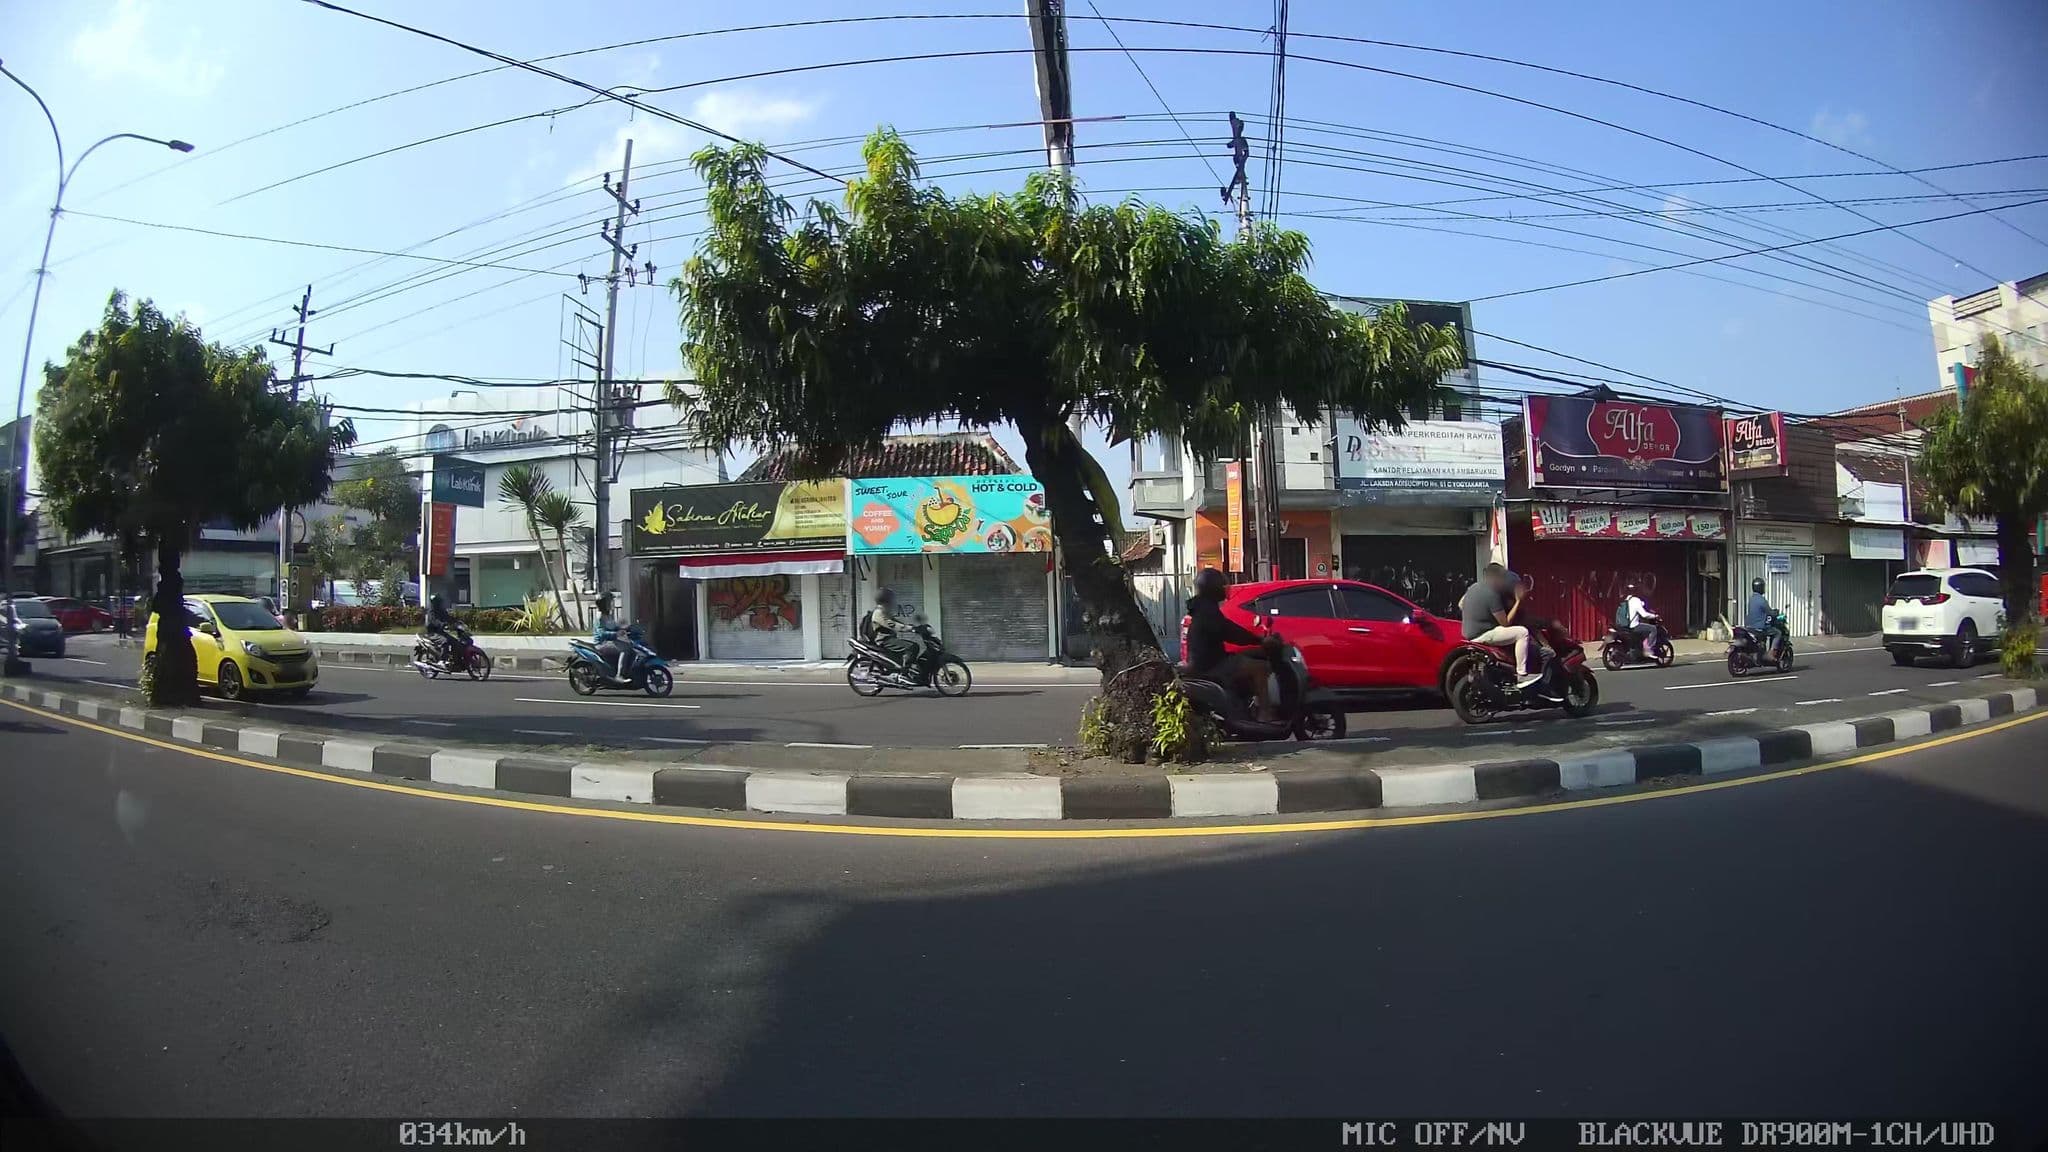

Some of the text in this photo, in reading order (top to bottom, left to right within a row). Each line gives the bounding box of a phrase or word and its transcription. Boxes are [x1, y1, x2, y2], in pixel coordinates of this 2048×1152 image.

[1604, 406, 1656, 453] Alfa
[1735, 416, 1763, 449] Alfa
[1407, 430, 1464, 439] PERKREDITAN
[1466, 432, 1497, 441] RAKYAT
[1643, 442, 1671, 452] DEOR
[1373, 466, 1401, 475] KANTOR
[1402, 467, 1440, 475] PELAYANAN
[1549, 463, 1576, 474] Gordyn
[972, 482, 1038, 492] HOT & COLD
[887, 490, 909, 500] SOUR
[863, 510, 893, 518] COFFEE
